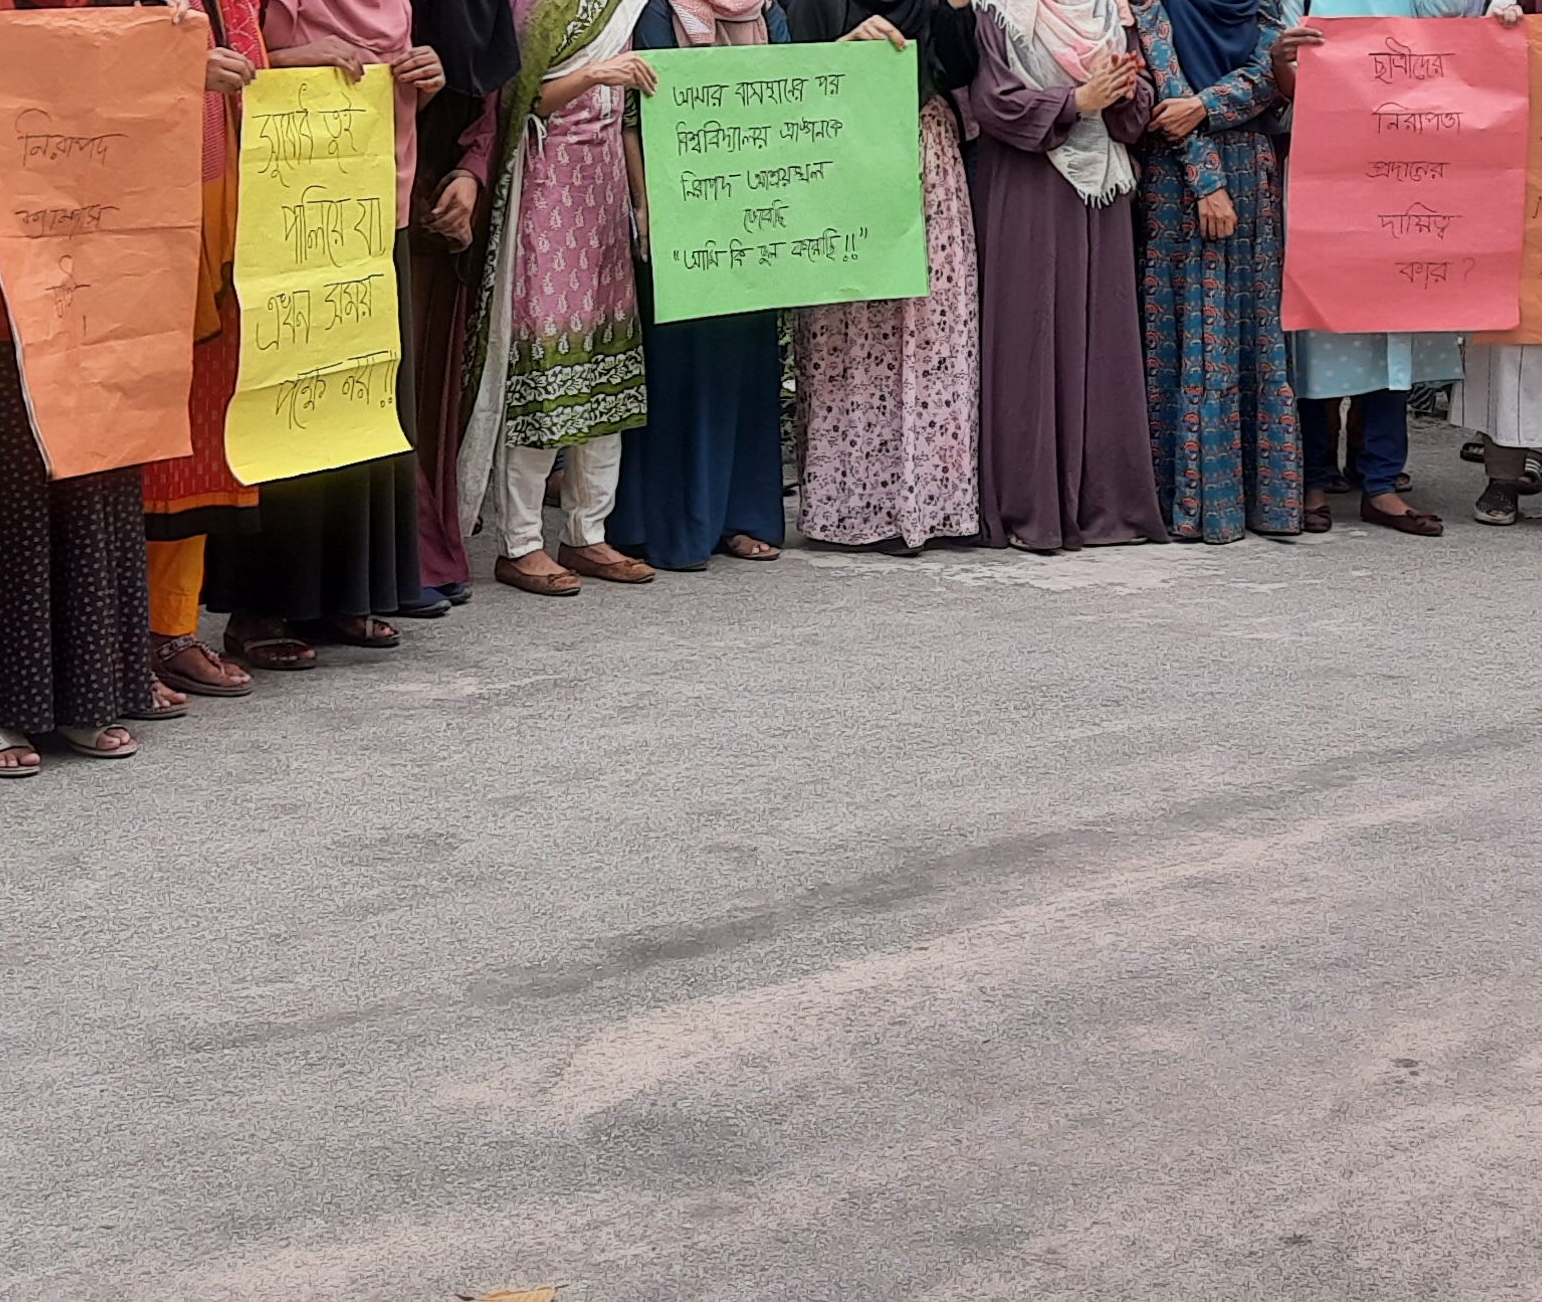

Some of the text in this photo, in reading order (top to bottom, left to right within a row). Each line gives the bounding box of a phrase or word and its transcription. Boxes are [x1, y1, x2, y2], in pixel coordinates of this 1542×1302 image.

[1368, 37, 1456, 84] ছাত্রীদের
[672, 74, 846, 110] আমার বাসস্থানের পর
[15, 108, 129, 166] নিরাপদ
[252, 83, 367, 187] সুবোধ তুই
[1371, 102, 1464, 134] নিরাপত্তা
[676, 119, 772, 157] বিশ্ববিদ্যালয়
[680, 161, 834, 201] নিরাপদ আশ্রয়স্থল
[1365, 160, 1451, 182] প্রদানের
[281, 185, 352, 268] পালিয়ে
[1378, 202, 1463, 239] দায়িত্ব
[729, 238, 755, 269] কি
[756, 241, 787, 267] ভুল
[1395, 261, 1455, 290] কার
[256, 273, 385, 350] এখন সময়
